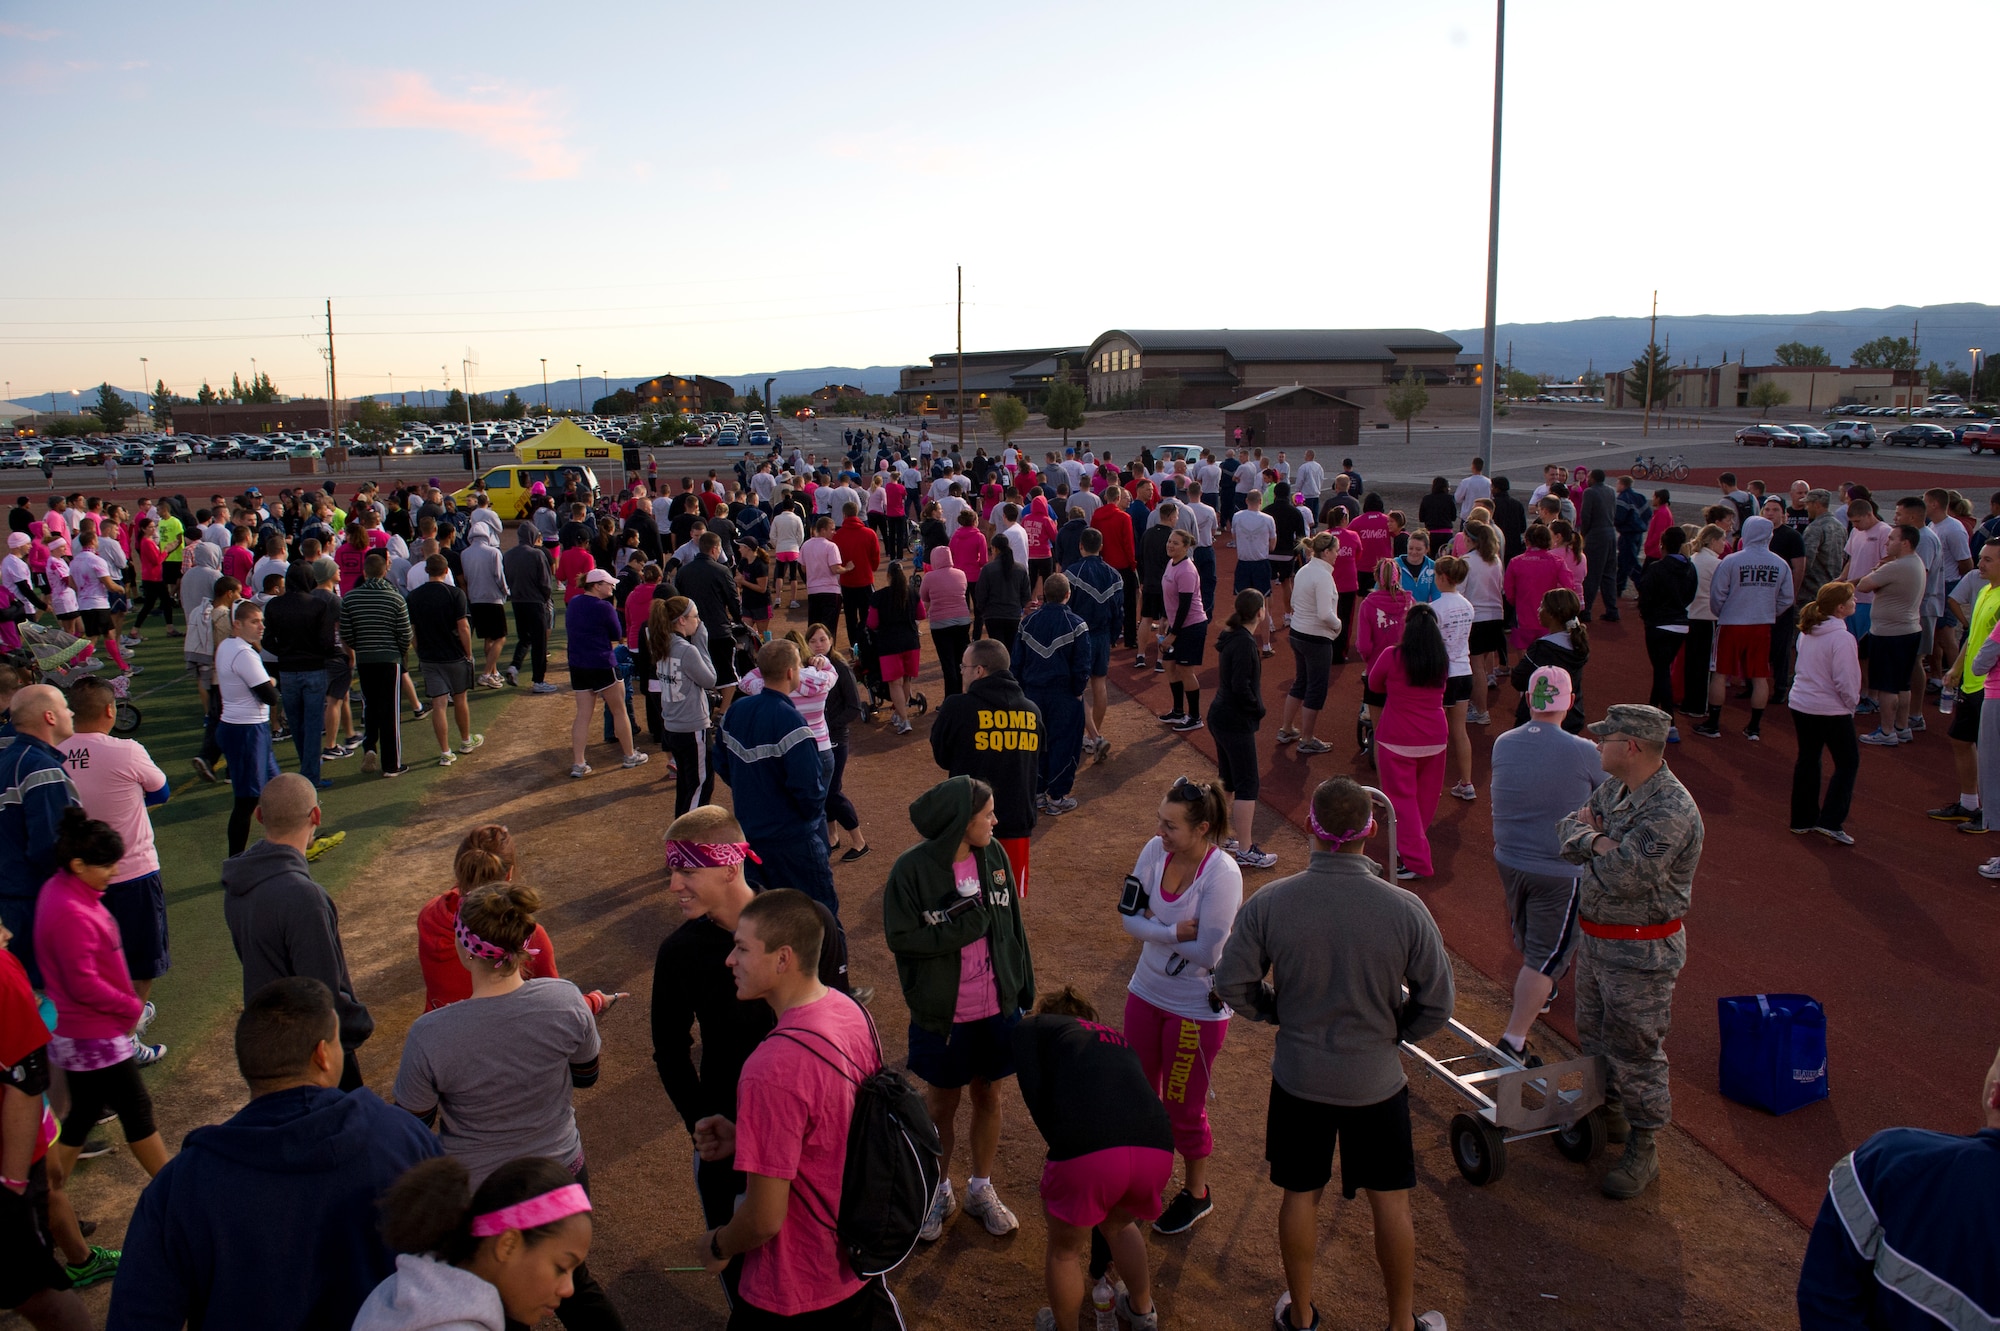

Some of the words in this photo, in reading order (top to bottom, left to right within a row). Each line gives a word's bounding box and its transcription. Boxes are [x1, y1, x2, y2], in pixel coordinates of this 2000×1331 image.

[1361, 528, 1387, 539] ZUMBA
[1740, 569, 1779, 582] FIRE
[978, 709, 1037, 731] BOMB
[974, 730, 1039, 753] SQUAD
[68, 747, 90, 759] MA
[68, 758, 90, 769] TE
[1178, 1019, 1201, 1050] AIR
[1167, 1051, 1196, 1104] FORCE
